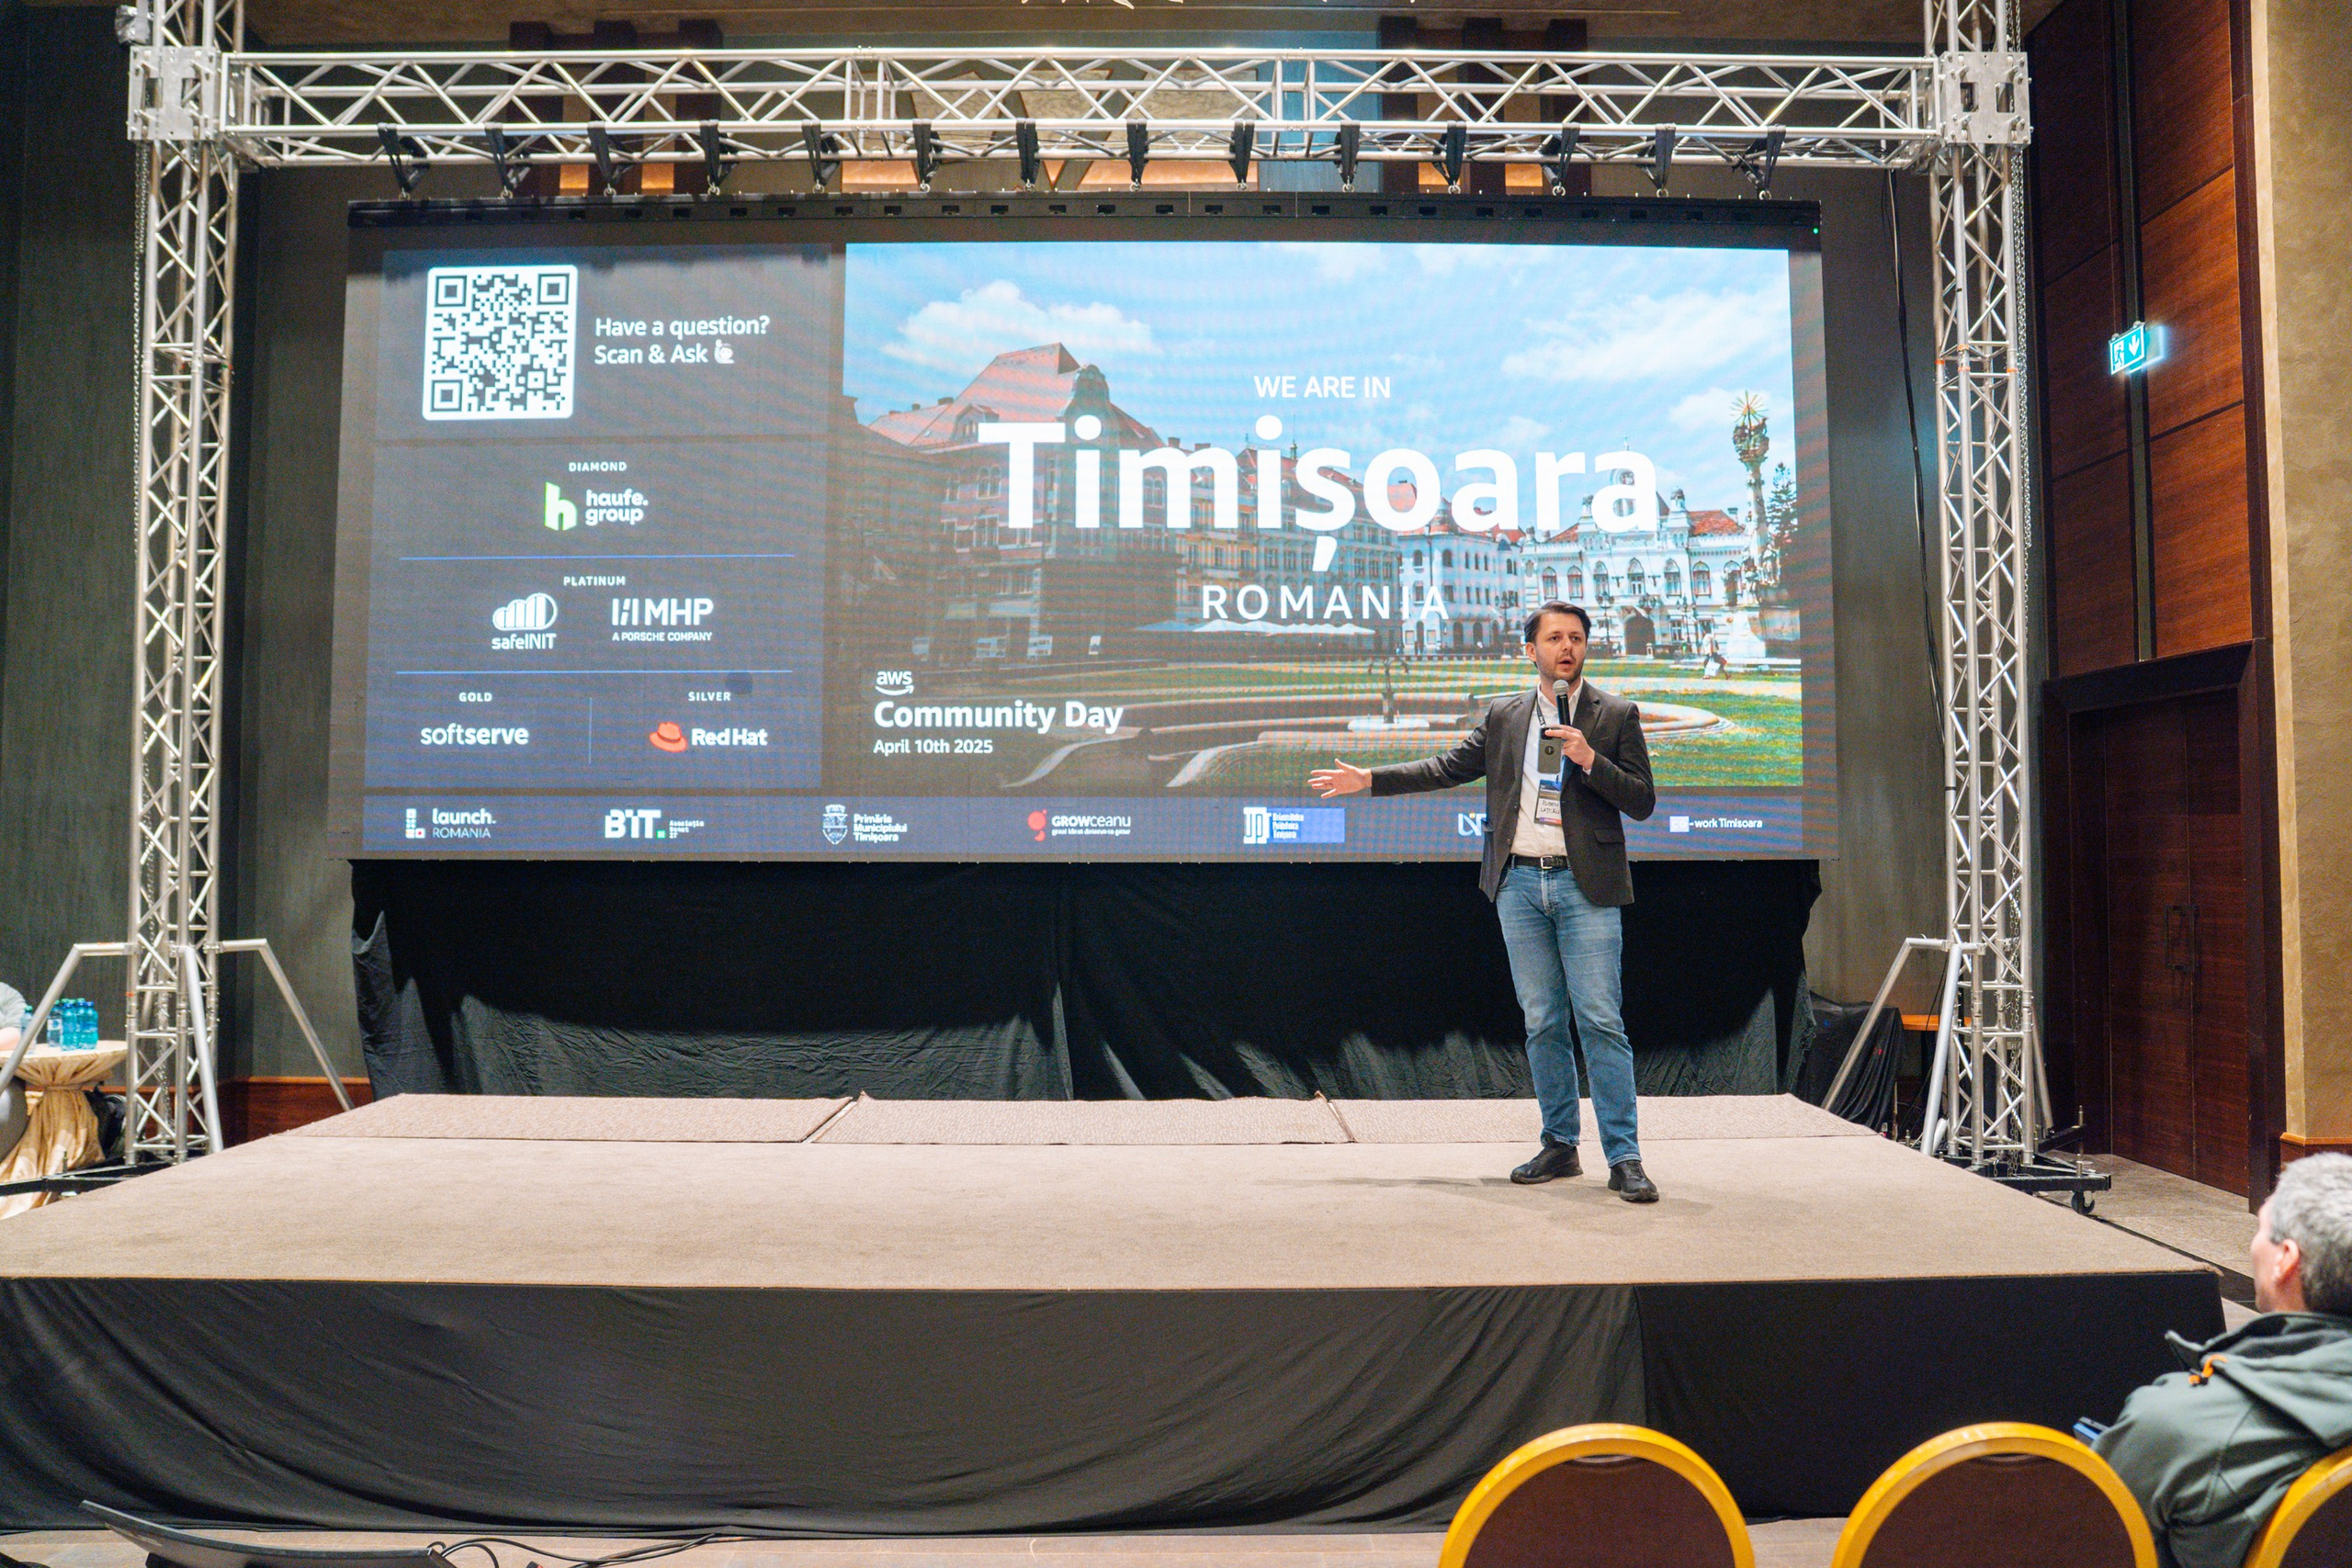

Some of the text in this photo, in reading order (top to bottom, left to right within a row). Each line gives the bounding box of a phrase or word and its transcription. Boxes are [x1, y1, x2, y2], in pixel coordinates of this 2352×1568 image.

[595, 314, 770, 340] Have a question?
[594, 343, 708, 365] Scan & Ask
[1253, 375, 1391, 400] WE ARE IN
[568, 461, 628, 472] DIAMOND
[585, 488, 649, 507] haufe.
[978, 414, 1658, 573] Timișoara
[585, 506, 644, 526] group
[563, 575, 626, 587] PLATINUM
[1202, 585, 1451, 621] ROMANIA
[612, 631, 712, 642] A PORSCHE COMPANY
[875, 671, 913, 686] aws
[458, 692, 492, 703] GOLD
[688, 691, 731, 702] SILVER
[874, 699, 1125, 735] Community Day
[420, 722, 529, 745] softserve
[691, 728, 768, 746] Red Hat
[873, 738, 993, 756] April 10th 2025
[1051, 815, 1132, 828] GROWceanu
[432, 827, 492, 839] ROMANIA
